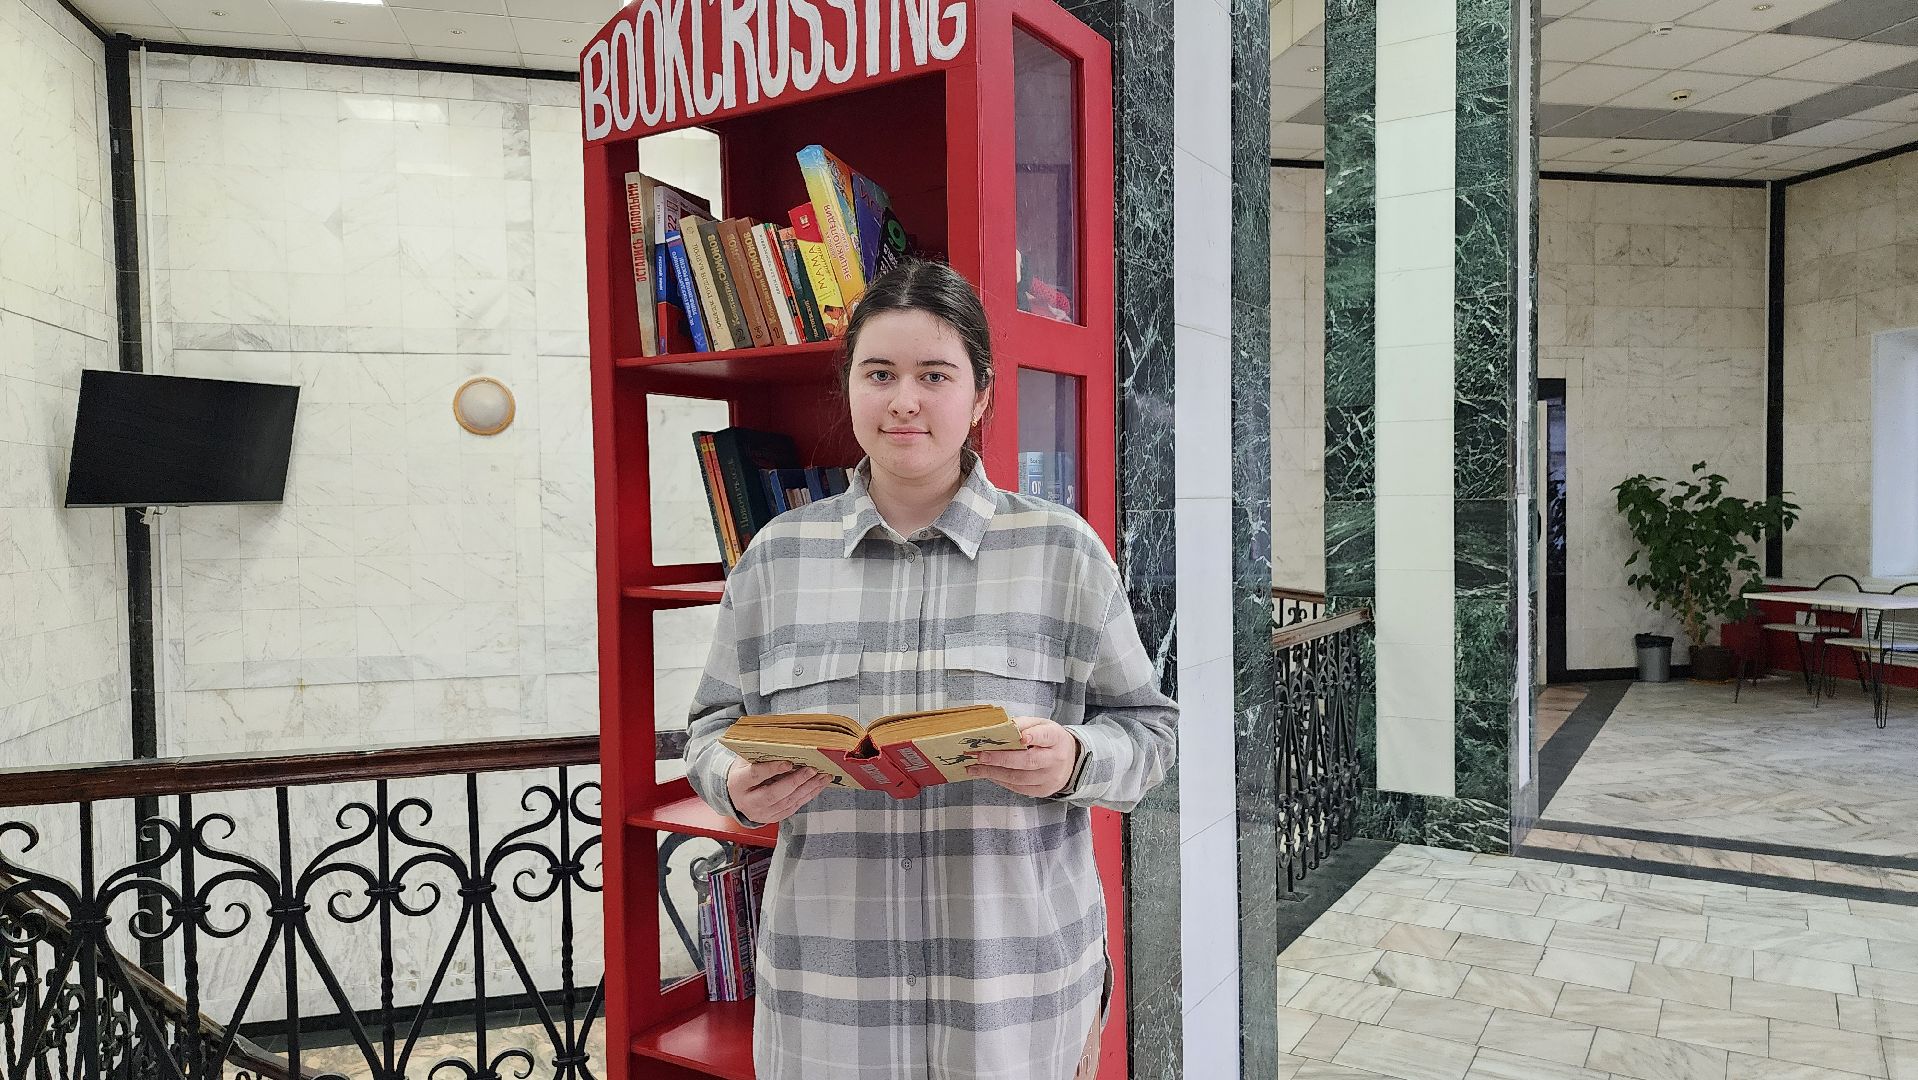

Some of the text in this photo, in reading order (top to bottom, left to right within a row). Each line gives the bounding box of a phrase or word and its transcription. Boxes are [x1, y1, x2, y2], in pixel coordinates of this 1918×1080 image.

[583, 0, 967, 141] BOOKCROSSING
[628, 183, 647, 282] ОСТАЛИСЬ МОЛОДЫМИ
[743, 231, 763, 279] СИМОНОВ
[823, 204, 852, 281] ЭНЦИКЛОПЕДИЯ
[679, 256, 688, 277] РОССИИ
[707, 233, 727, 281] СИМОНОВ
[809, 244, 828, 290] МАМА
[759, 278, 777, 325] Константин
[735, 328, 745, 342] 2
